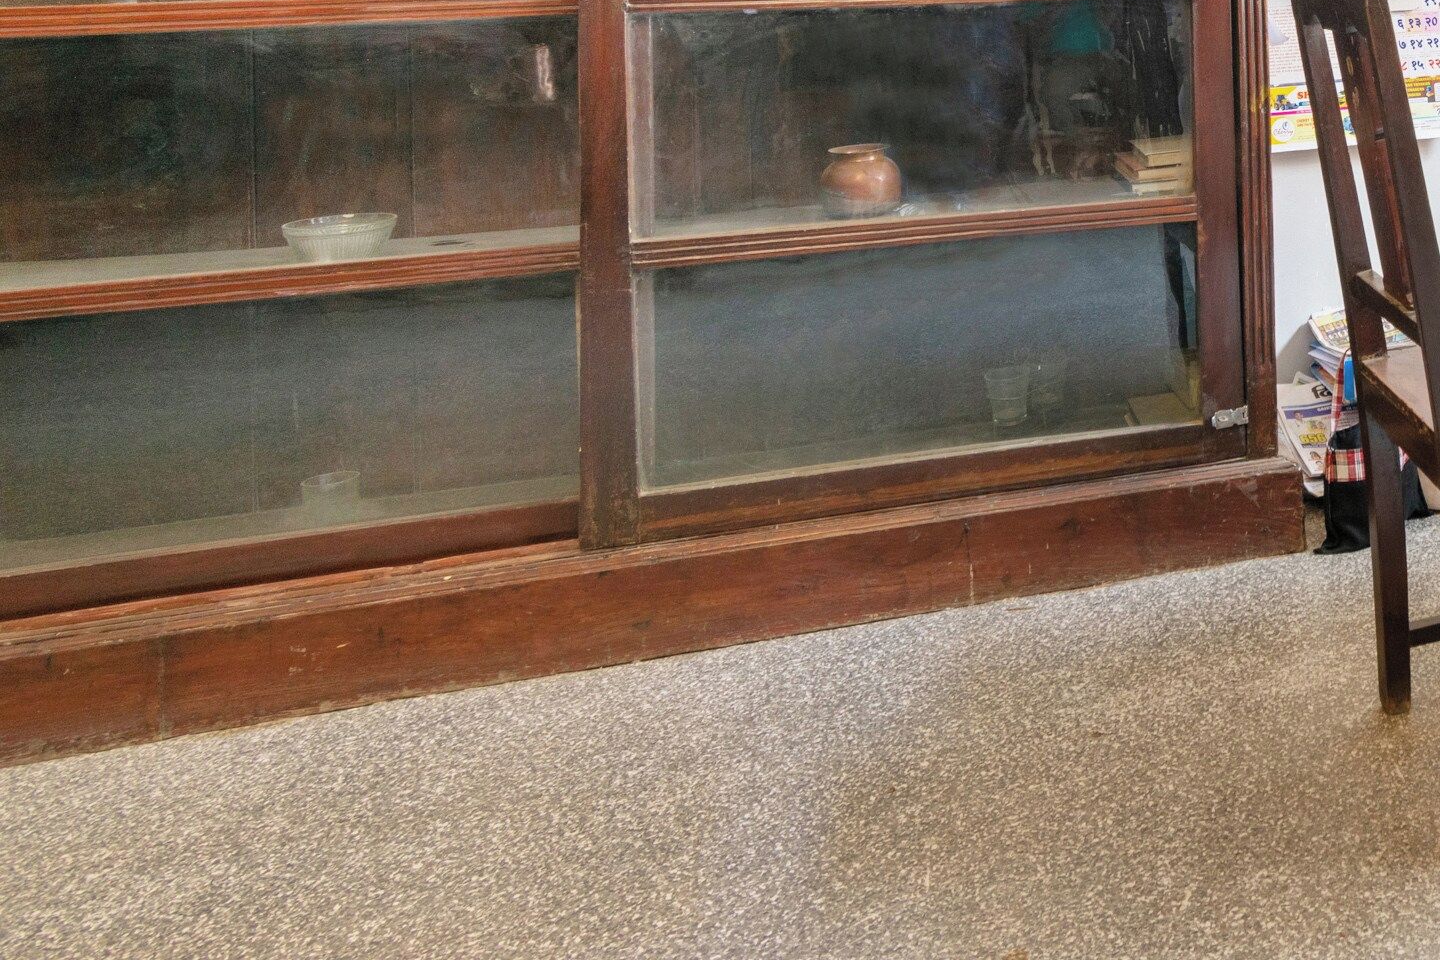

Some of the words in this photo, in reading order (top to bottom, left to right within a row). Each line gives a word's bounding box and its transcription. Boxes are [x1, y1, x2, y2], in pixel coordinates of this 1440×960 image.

[1397, 19, 1405, 29] ६
[1408, 18, 1421, 28] १३
[1425, 16, 1438, 27] २०
[1398, 40, 1407, 50] ७
[1410, 39, 1423, 49] १४
[1426, 38, 1439, 48] २१
[1411, 60, 1425, 71] १५
[1428, 59, 1440, 69] २२
